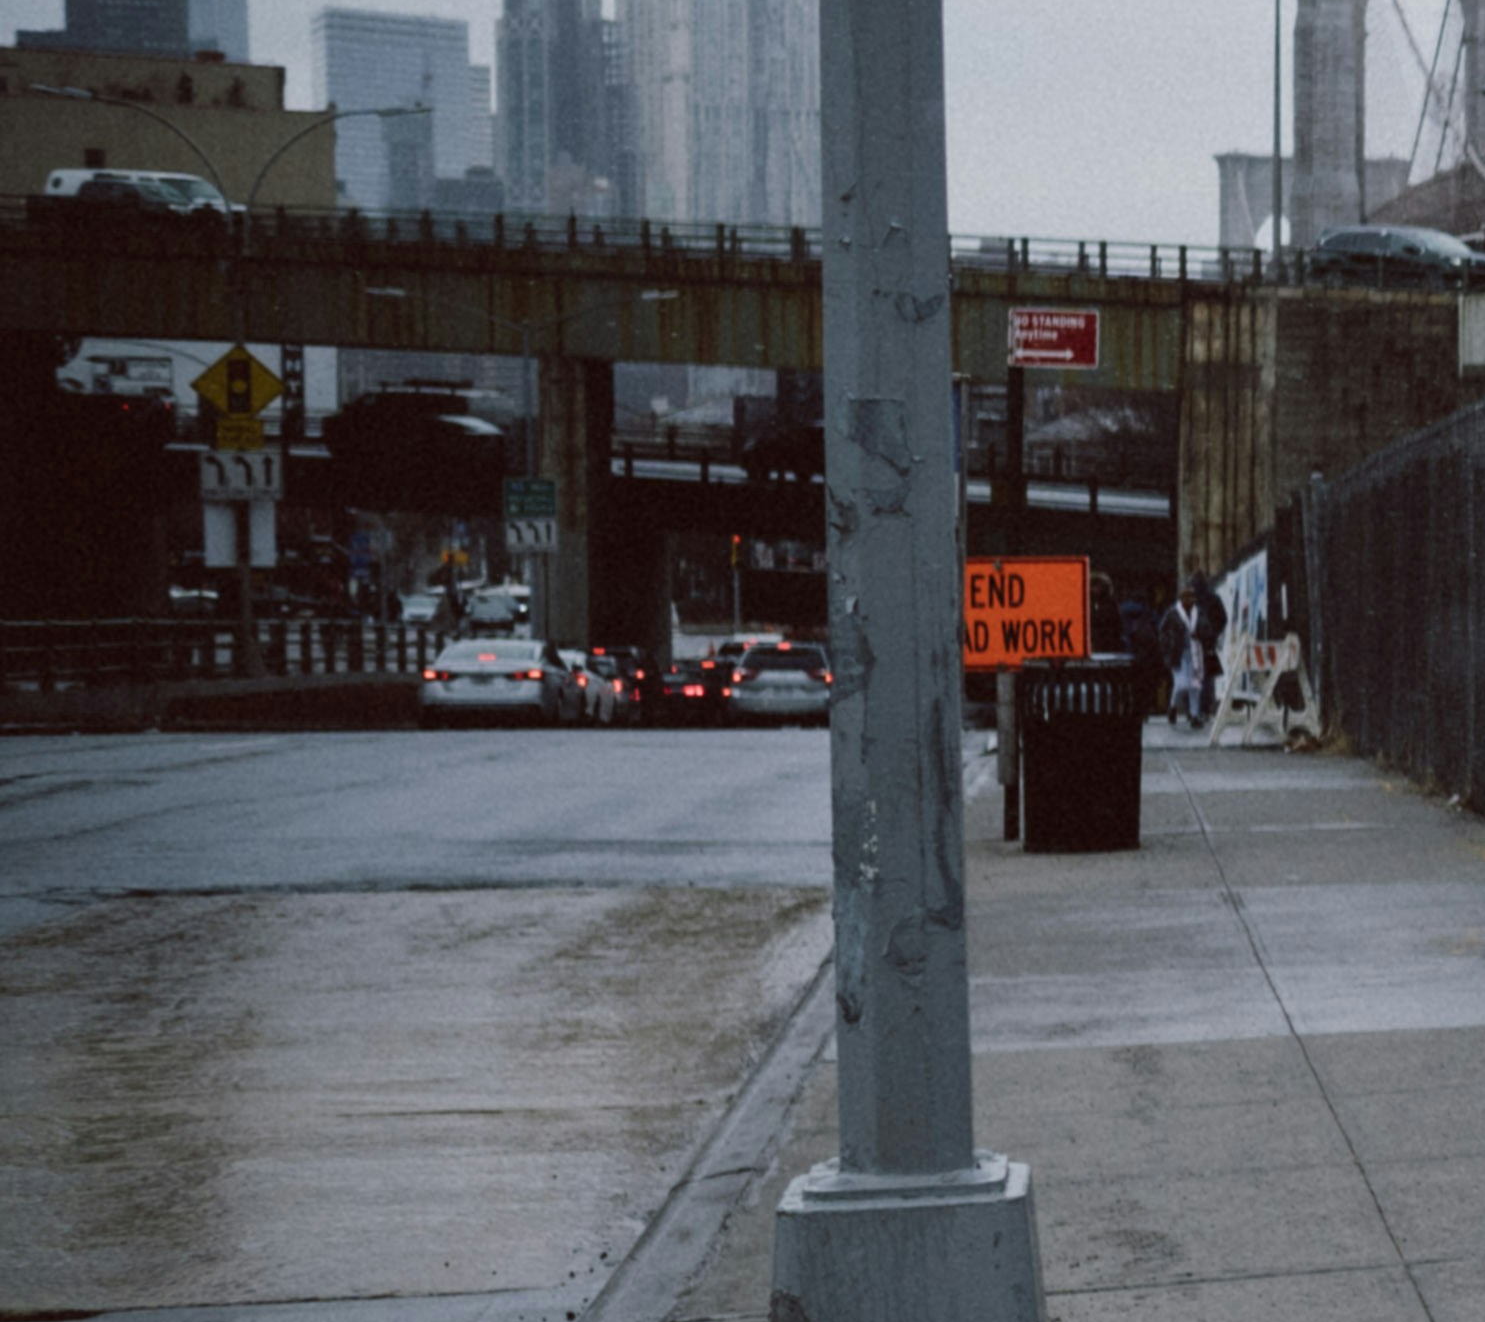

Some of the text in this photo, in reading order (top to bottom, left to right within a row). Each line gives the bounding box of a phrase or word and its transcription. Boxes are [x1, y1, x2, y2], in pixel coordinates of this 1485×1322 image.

[1032, 314, 1085, 329] STANDING
[1015, 329, 1058, 342] Anytime
[971, 574, 1024, 608] END
[1001, 620, 1074, 652] WORK
